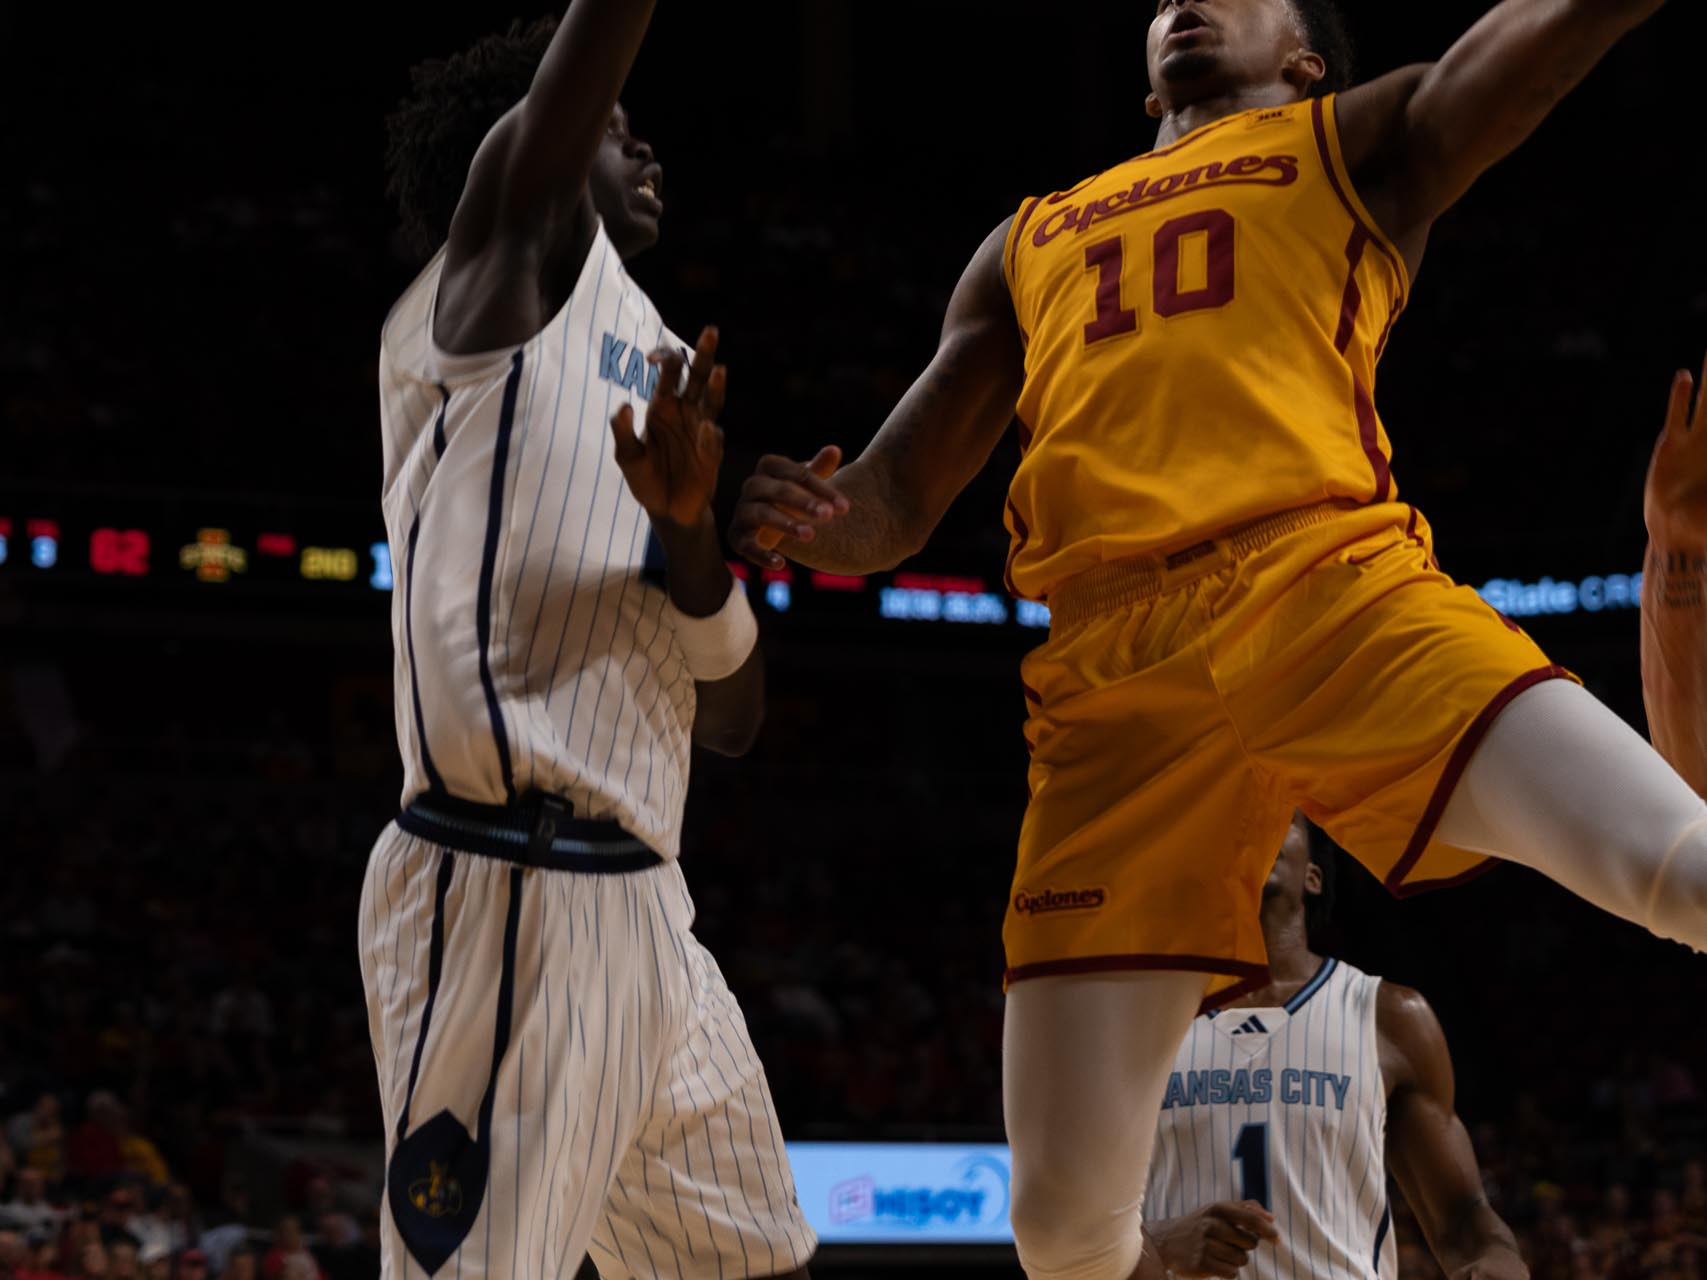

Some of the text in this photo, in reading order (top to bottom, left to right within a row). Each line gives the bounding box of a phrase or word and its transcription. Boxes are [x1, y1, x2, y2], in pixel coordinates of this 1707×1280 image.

[1032, 154, 1299, 248] Cyclones
[1084, 209, 1235, 346] 10
[1015, 888, 1105, 915] Cyclones
[1162, 1068, 1351, 1111] ANSAS CITY
[1231, 1121, 1271, 1212] 1
